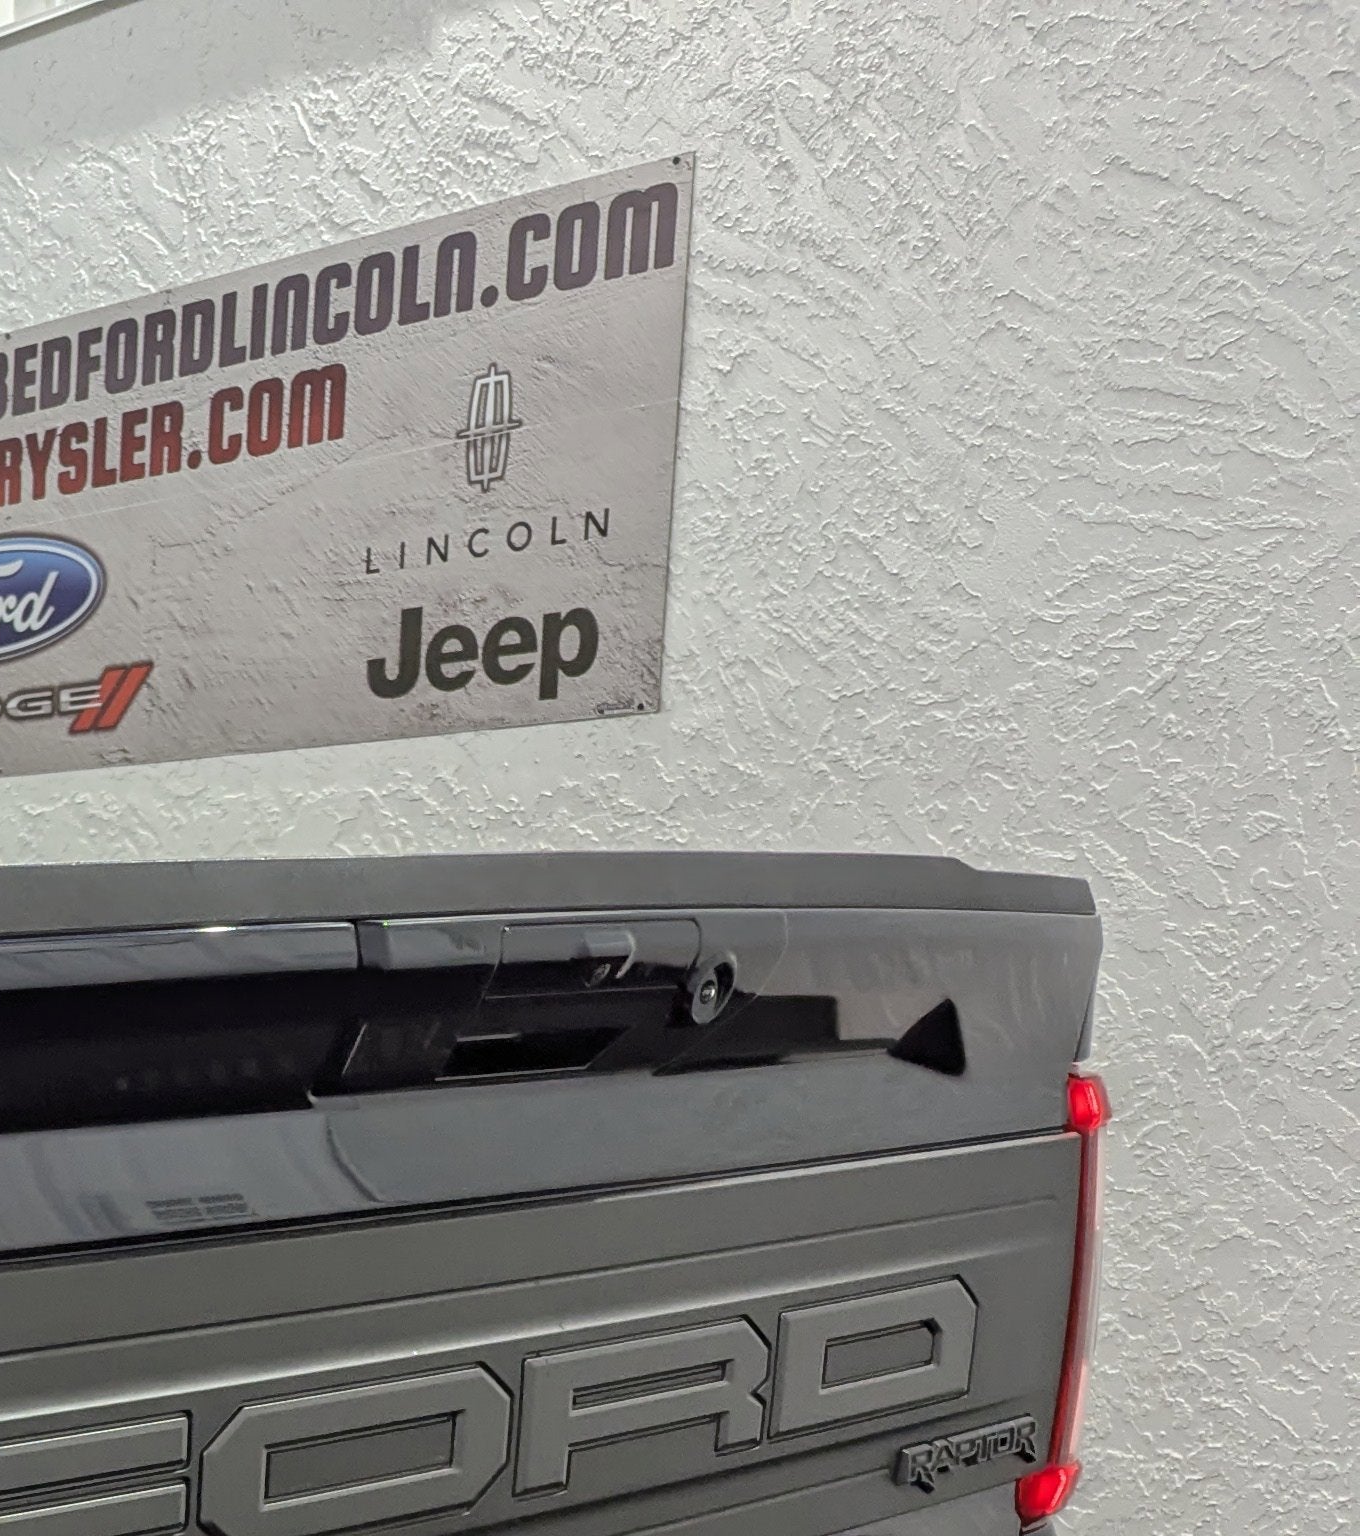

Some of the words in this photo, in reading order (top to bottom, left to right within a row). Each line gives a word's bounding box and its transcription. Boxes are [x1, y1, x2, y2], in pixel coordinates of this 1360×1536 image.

[365, 507, 610, 575] LINCOLN
[365, 605, 600, 701] Jeep
[893, 1414, 1038, 1494] RAPTOR
